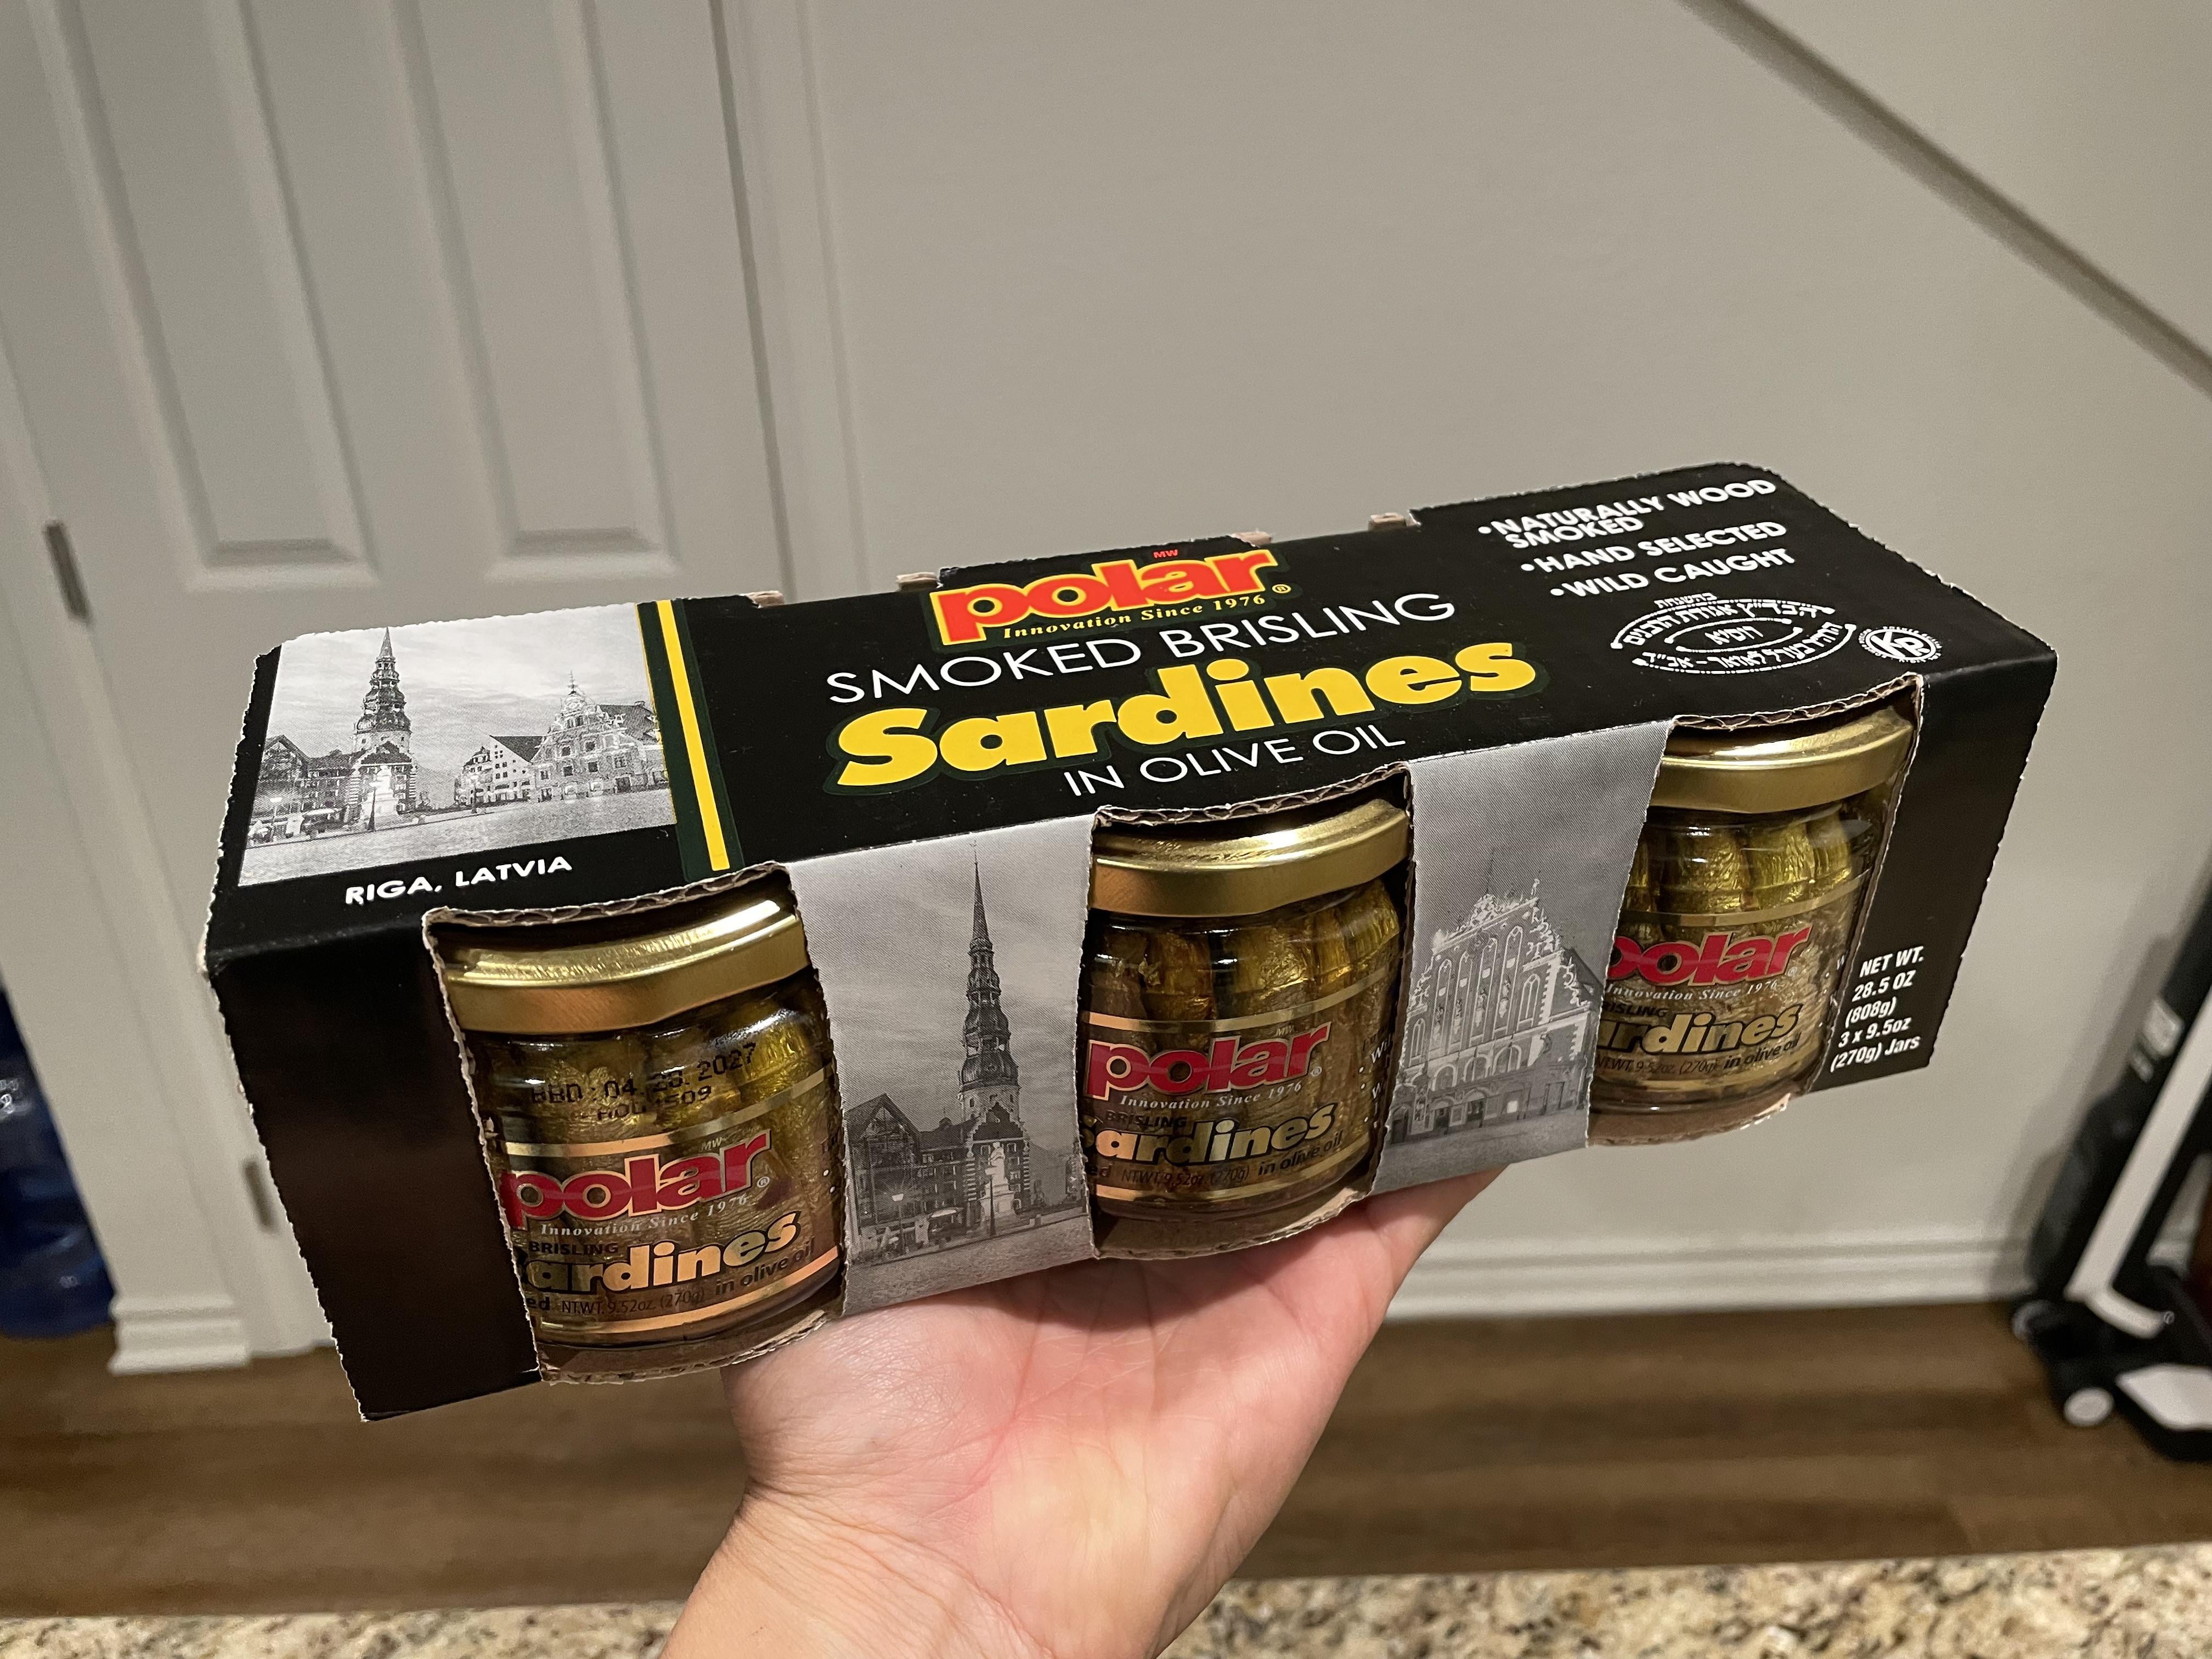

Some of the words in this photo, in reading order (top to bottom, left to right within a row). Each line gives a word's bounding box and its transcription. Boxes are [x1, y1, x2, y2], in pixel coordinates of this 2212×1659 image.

[1491, 496, 1664, 534] NATURALLY
[1667, 479, 1776, 506] WOOD
[1153, 549, 1178, 558] MW
[1505, 517, 1643, 548] SMOKED
[1534, 546, 1635, 572] HAND
[1638, 522, 1786, 556] SELECTED
[1561, 573, 1648, 596] WILD
[1654, 549, 1795, 582] CAUGHT
[930, 550, 1278, 645] polar
[1003, 613, 1131, 639] Innovation
[1141, 604, 1203, 620] Since
[1213, 595, 1265, 611] 1976
[827, 639, 1141, 703] SMOKED
[1159, 594, 1454, 657] BRISLING
[836, 642, 1535, 786] Sardines
[1065, 766, 1125, 796] IN
[1140, 738, 1295, 782] OLIVE
[1313, 725, 1406, 754] OIL
[345, 877, 442, 905] RIGA,
[456, 856, 572, 887] LATVIA
[1859, 953, 1893, 978] NET
[1895, 946, 1924, 967] WT.
[1699, 988, 1741, 1001] Since
[1747, 979, 1779, 995] 1976
[1852, 976, 1891, 1002] 28.5
[1893, 970, 1916, 990] OZ
[1838, 1031, 1850, 1048] 3
[1852, 1029, 1863, 1043] x
[1865, 1017, 1912, 1040] 9.5oz
[1845, 996, 1897, 1028] (808g)
[1086, 1020, 1331, 1101] polar
[1724, 1055, 1740, 1069] in
[1743, 1042, 1781, 1064] olive
[1830, 1042, 1882, 1073] (270g)
[1884, 1036, 1921, 1056] Jars
[1120, 1095, 1209, 1109] Innovation
[1216, 1093, 1261, 1107] Since
[1268, 1081, 1302, 1099] 1976
[1105, 1109, 1188, 1127] BRISLING
[1258, 1161, 1276, 1176] in
[1279, 1146, 1320, 1170] olive
[1323, 1129, 1342, 1150] oil
[498, 1128, 771, 1229] polar
[540, 1221, 641, 1237] Innovation
[647, 1210, 698, 1229] Since
[707, 1192, 747, 1217] 1976
[516, 1210, 802, 1295] ardines
[528, 1240, 619, 1256] BRISLING
[660, 1289, 704, 1310] (270g)
[716, 1278, 735, 1295] in
[741, 1256, 788, 1288] olive
[793, 1235, 815, 1262] oil
